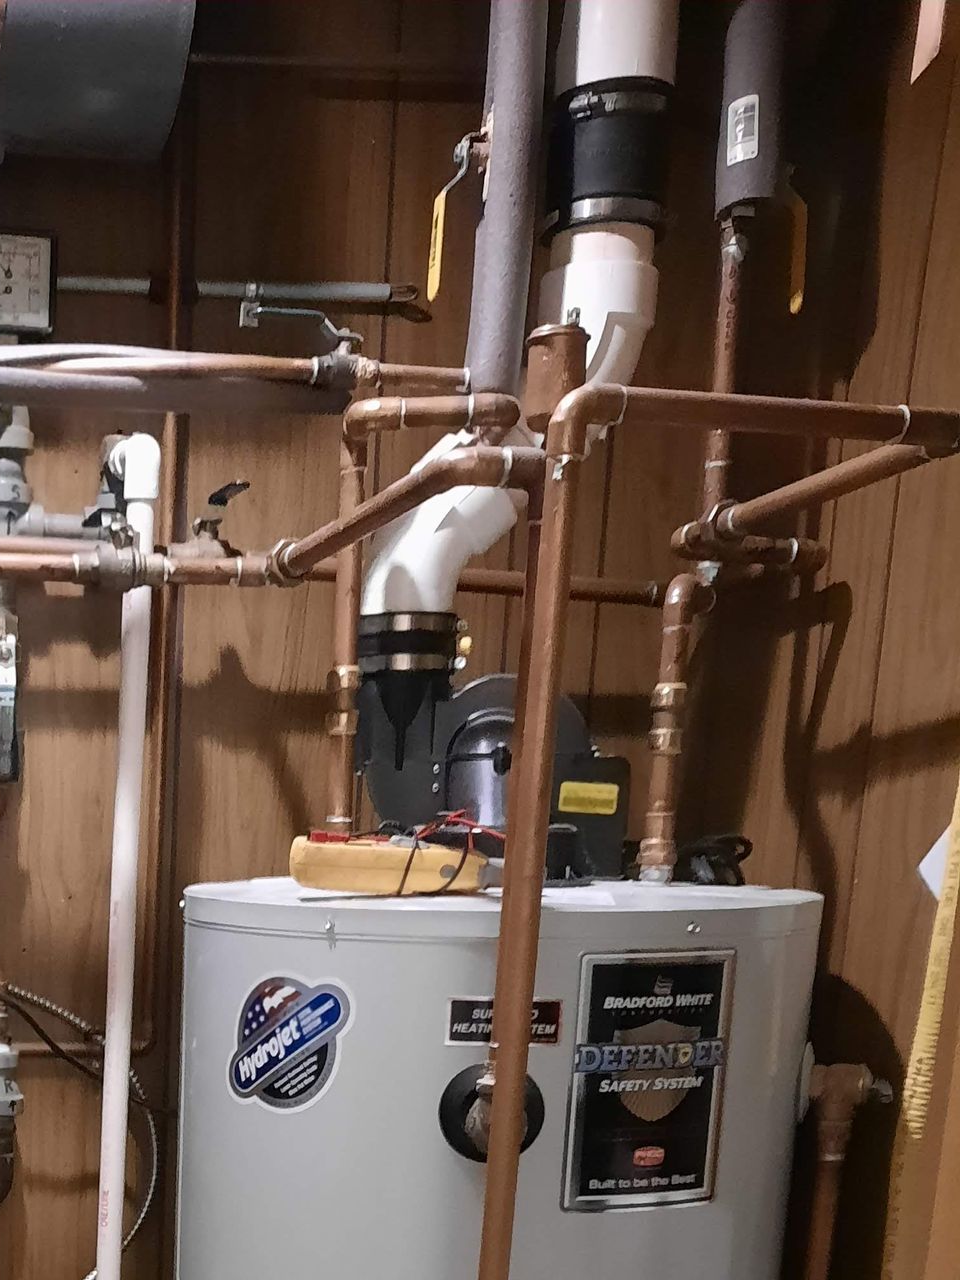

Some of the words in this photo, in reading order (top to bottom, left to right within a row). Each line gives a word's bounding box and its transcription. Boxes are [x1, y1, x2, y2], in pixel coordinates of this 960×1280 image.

[603, 995, 674, 1009] BRADFORD
[675, 993, 714, 1007] WHITE
[238, 1015, 301, 1082] Hydrojet
[576, 1040, 725, 1073] DEFENDER
[599, 1079, 651, 1093] SAFETY
[653, 1076, 704, 1090] SYSTEM
[619, 1178, 631, 1188] to
